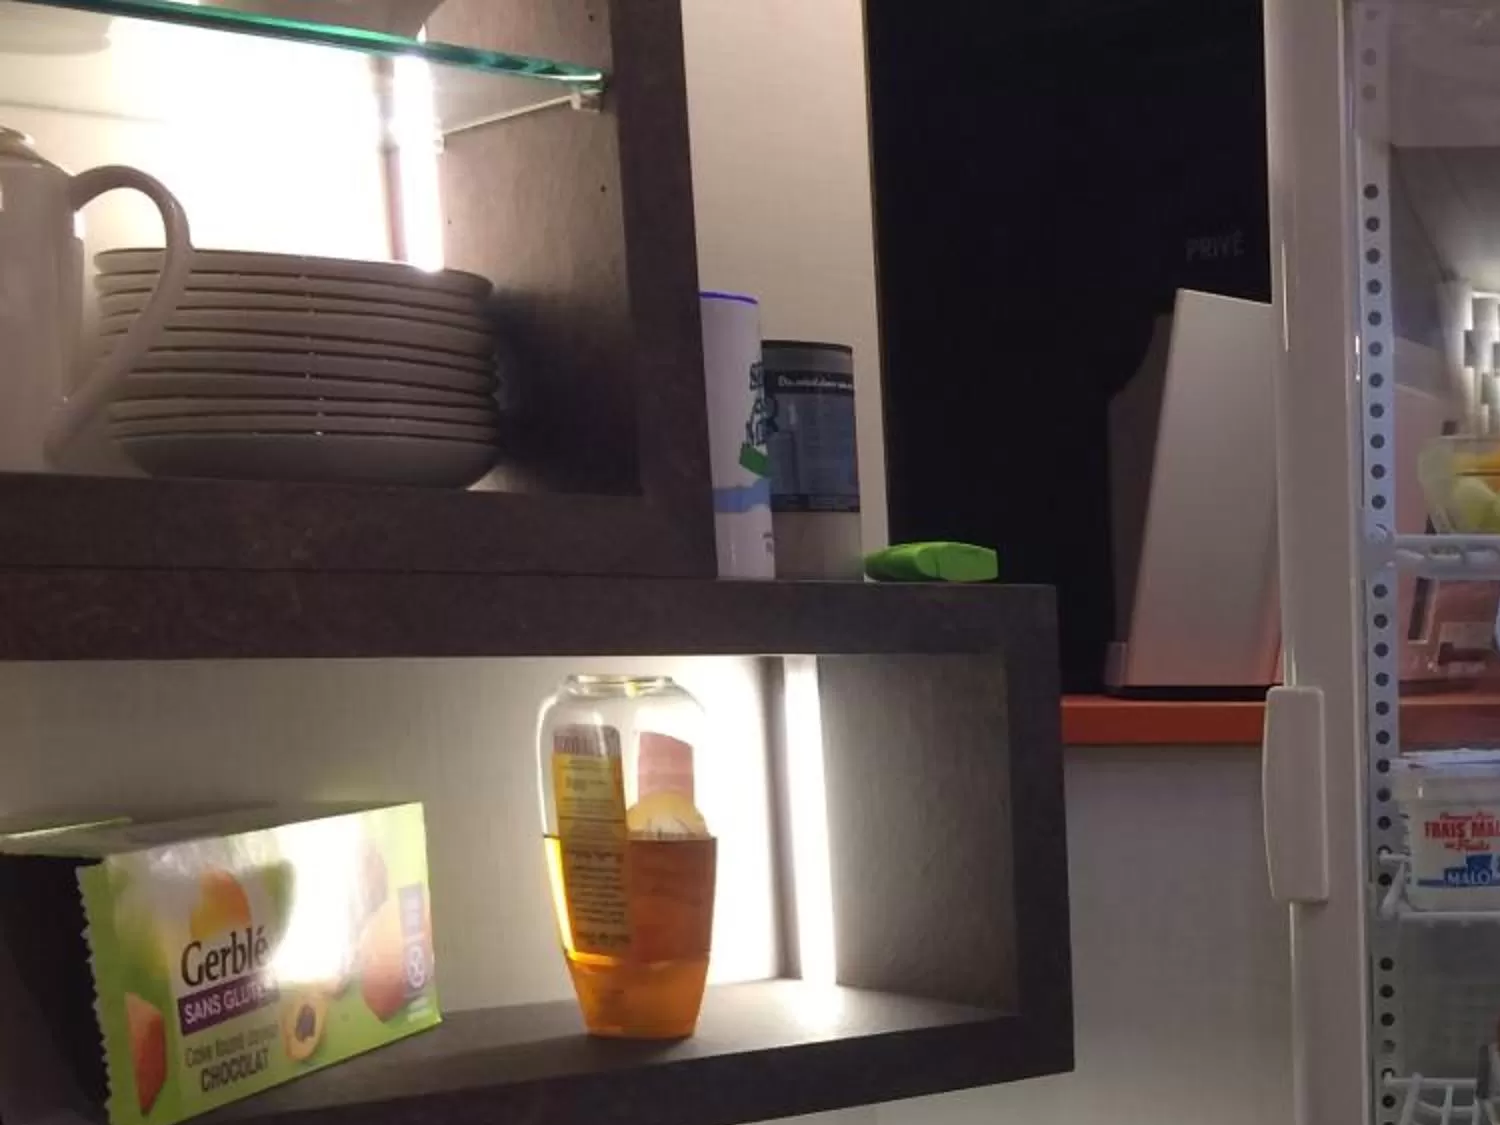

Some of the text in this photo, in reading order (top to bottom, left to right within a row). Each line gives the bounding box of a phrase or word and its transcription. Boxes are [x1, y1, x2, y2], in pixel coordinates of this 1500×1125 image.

[1446, 870, 1492, 886] MALO
[181, 925, 269, 987] Gerblé
[183, 993, 222, 1025] SANS
[201, 1047, 270, 1093] CHOCOLAT
